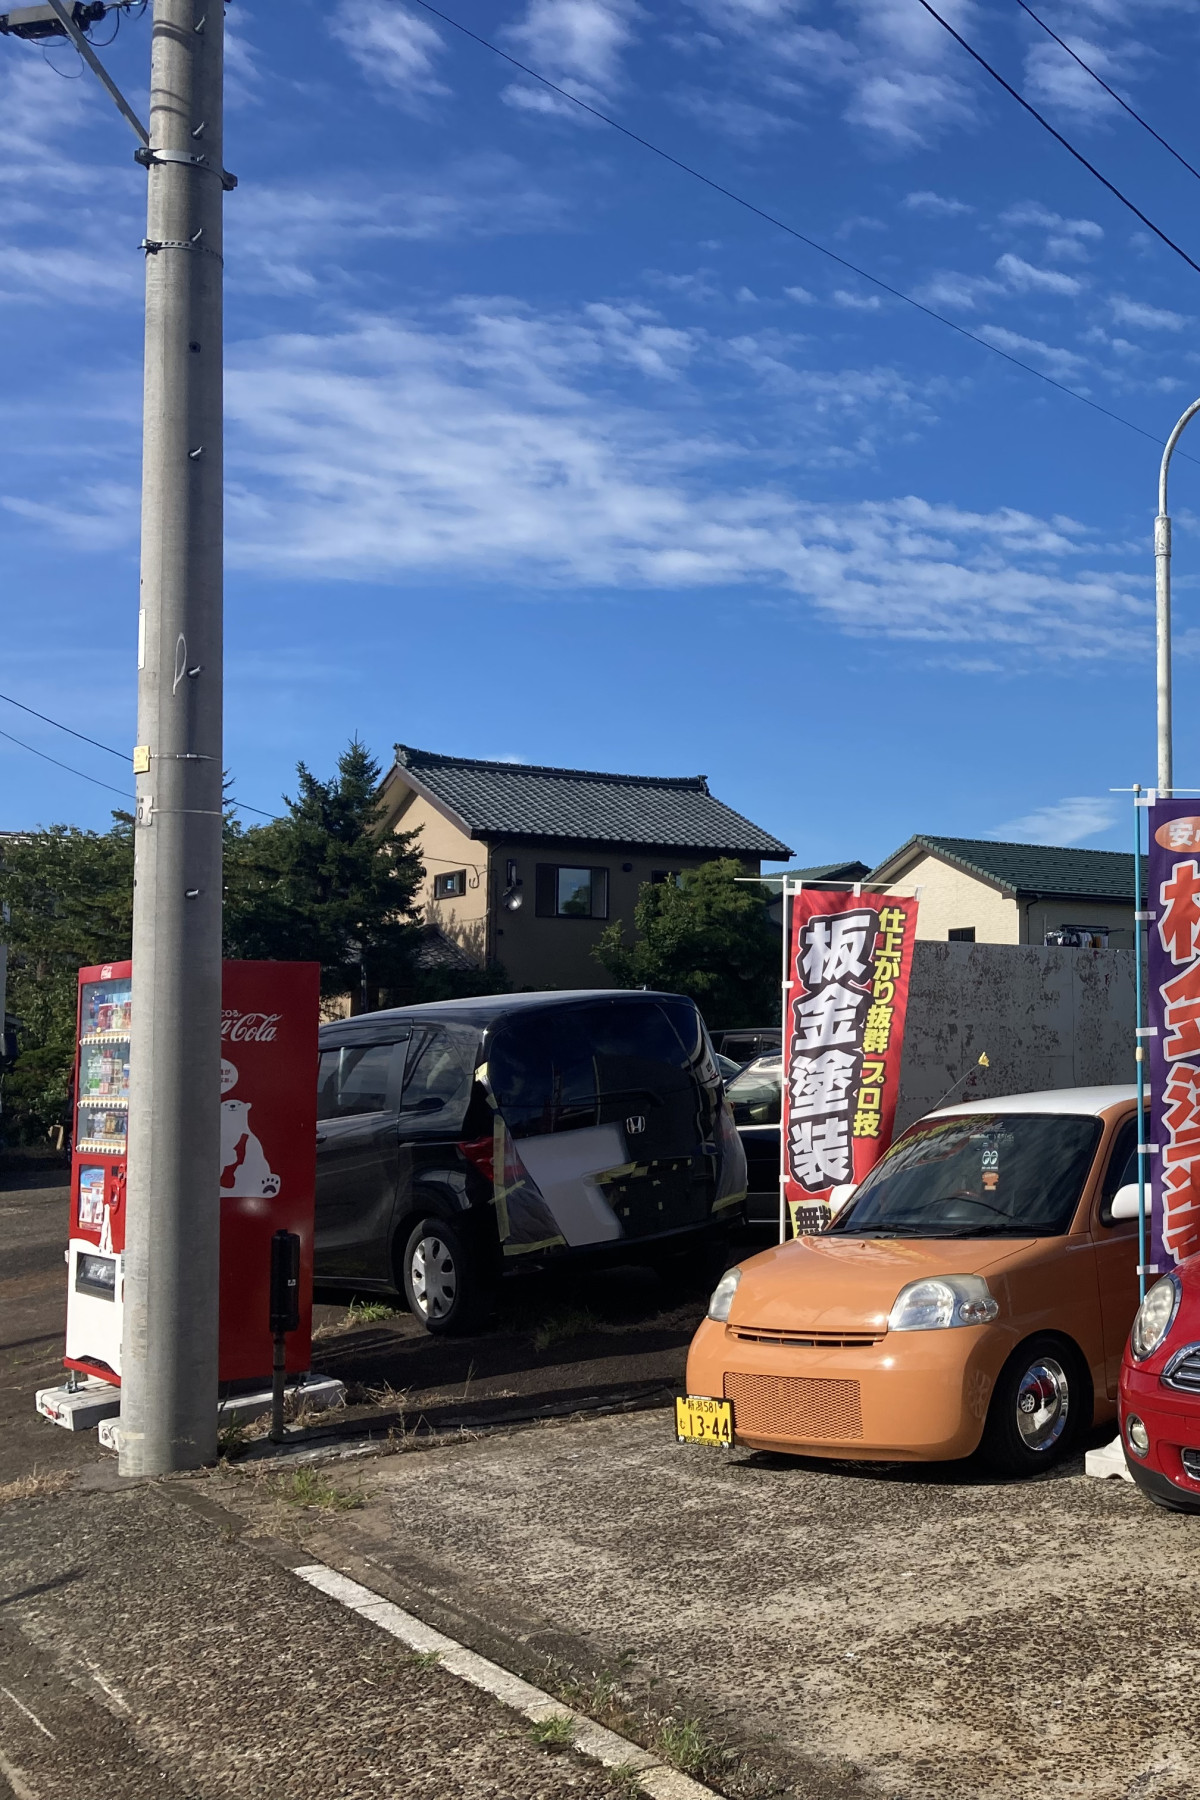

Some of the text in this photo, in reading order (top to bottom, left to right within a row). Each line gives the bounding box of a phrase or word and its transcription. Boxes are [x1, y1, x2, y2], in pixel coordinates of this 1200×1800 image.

[221, 1013, 283, 1041] a-Cola
[789, 913, 871, 1186] 板金塗装
[853, 907, 905, 1137] 仕上がり抜群 プロ技
[690, 1414, 730, 1441] 13-44
